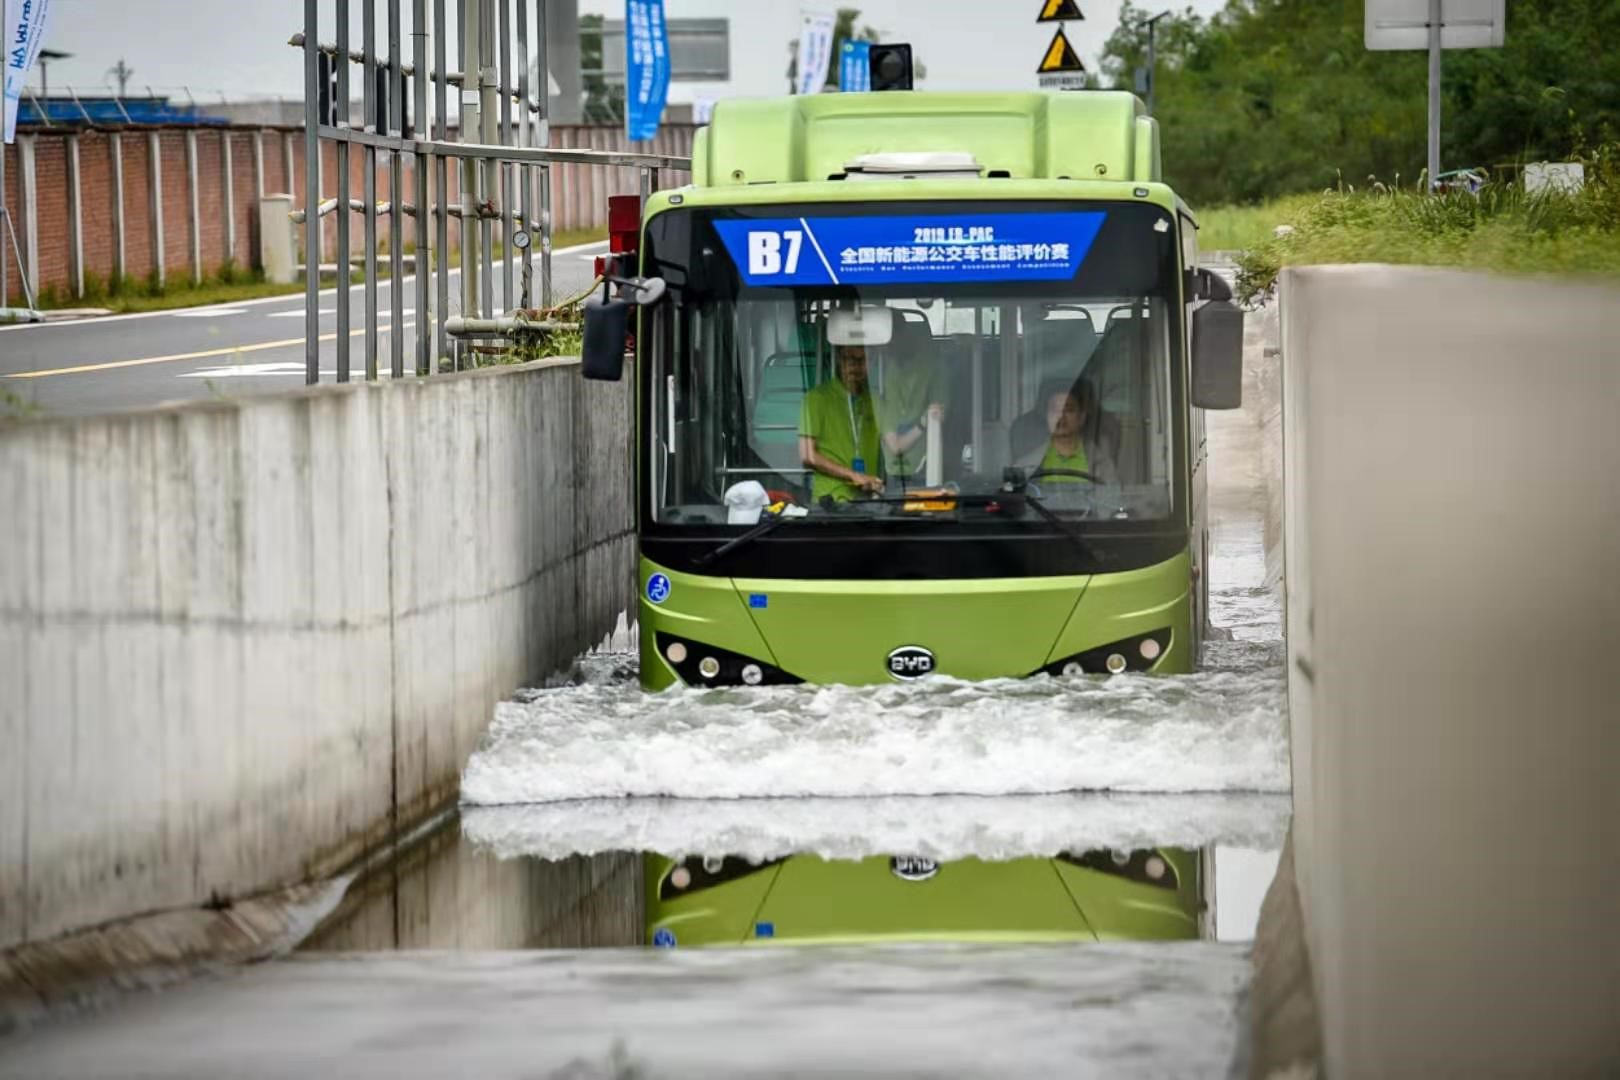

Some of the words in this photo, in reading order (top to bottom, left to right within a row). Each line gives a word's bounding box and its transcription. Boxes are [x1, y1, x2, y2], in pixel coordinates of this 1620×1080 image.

[748, 230, 803, 275] B7
[840, 243, 1069, 264] 全国新能源公交车性能评价赛
[891, 656, 931, 671] BYD
